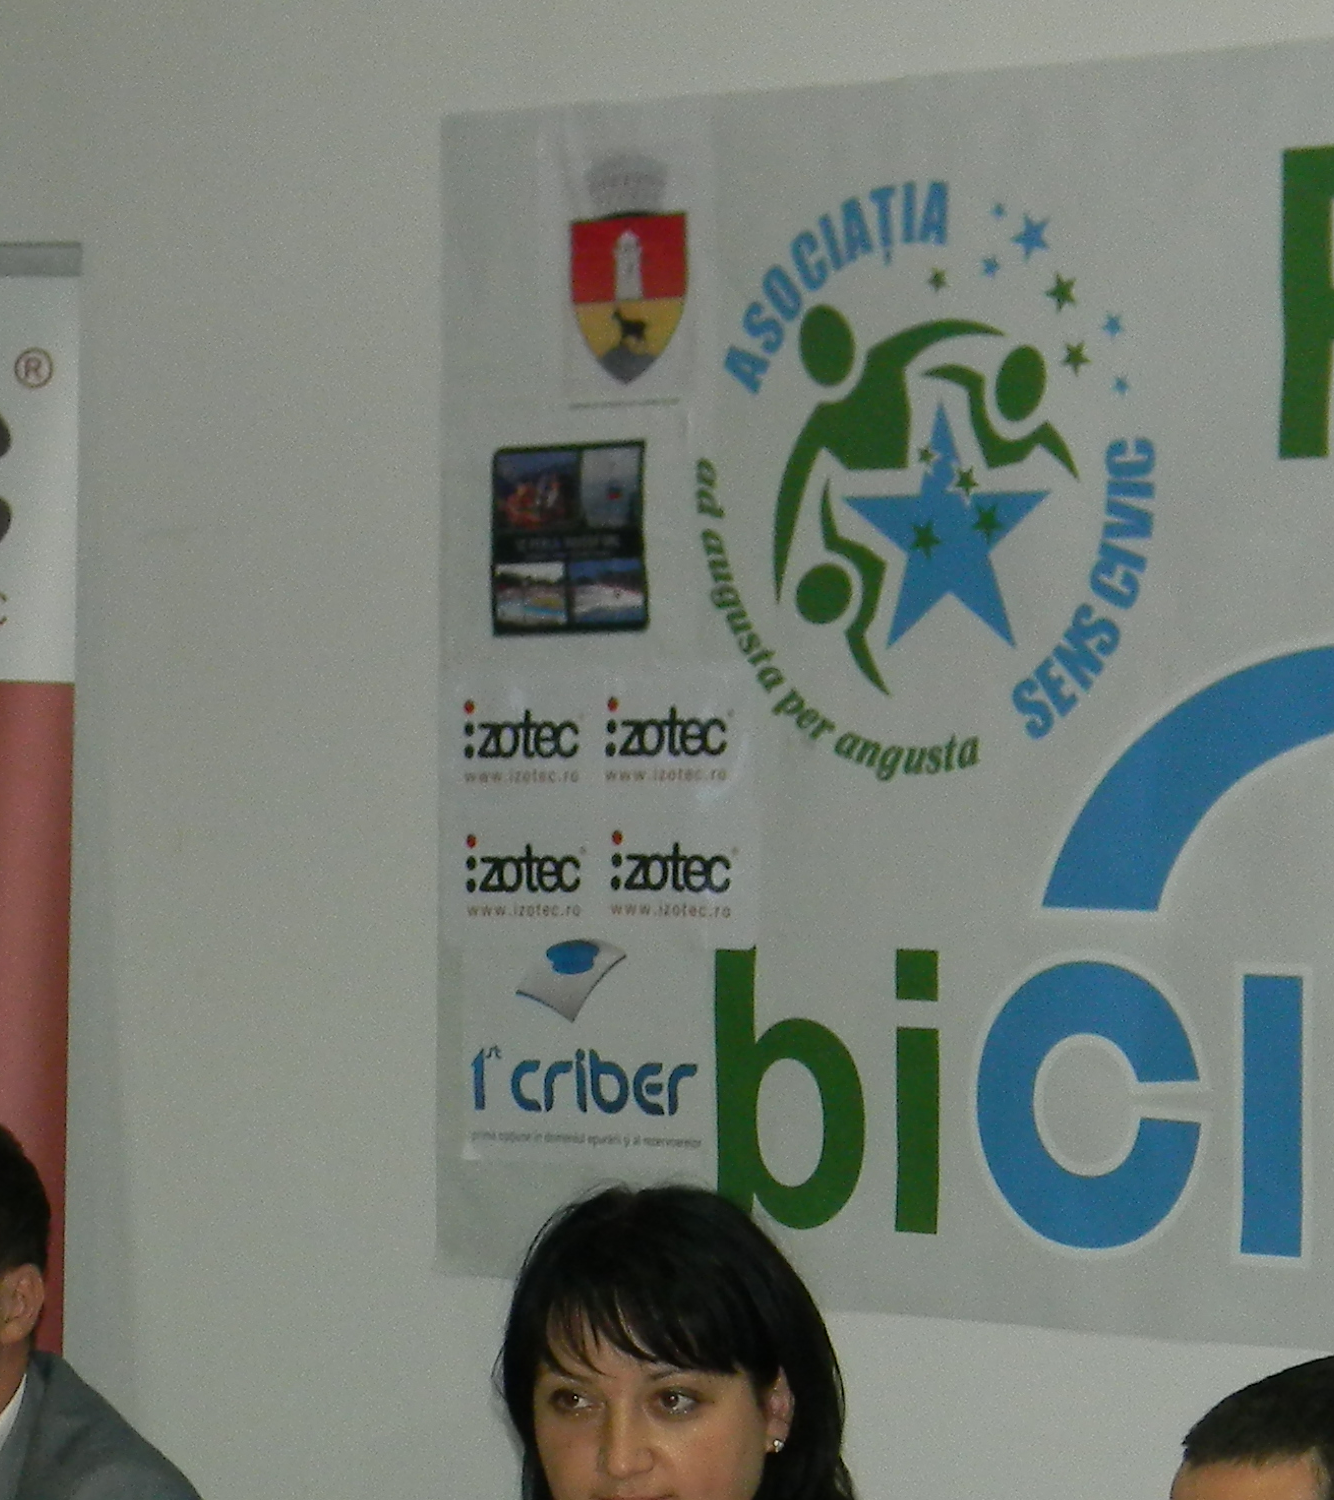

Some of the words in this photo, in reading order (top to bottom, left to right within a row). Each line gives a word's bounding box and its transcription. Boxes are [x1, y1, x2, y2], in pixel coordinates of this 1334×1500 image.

[701, 528, 786, 693] angusta
[771, 688, 836, 740] per
[834, 731, 981, 782] angusta
[1012, 602, 1121, 740] SENS
[1089, 436, 1156, 610] CIVIC
